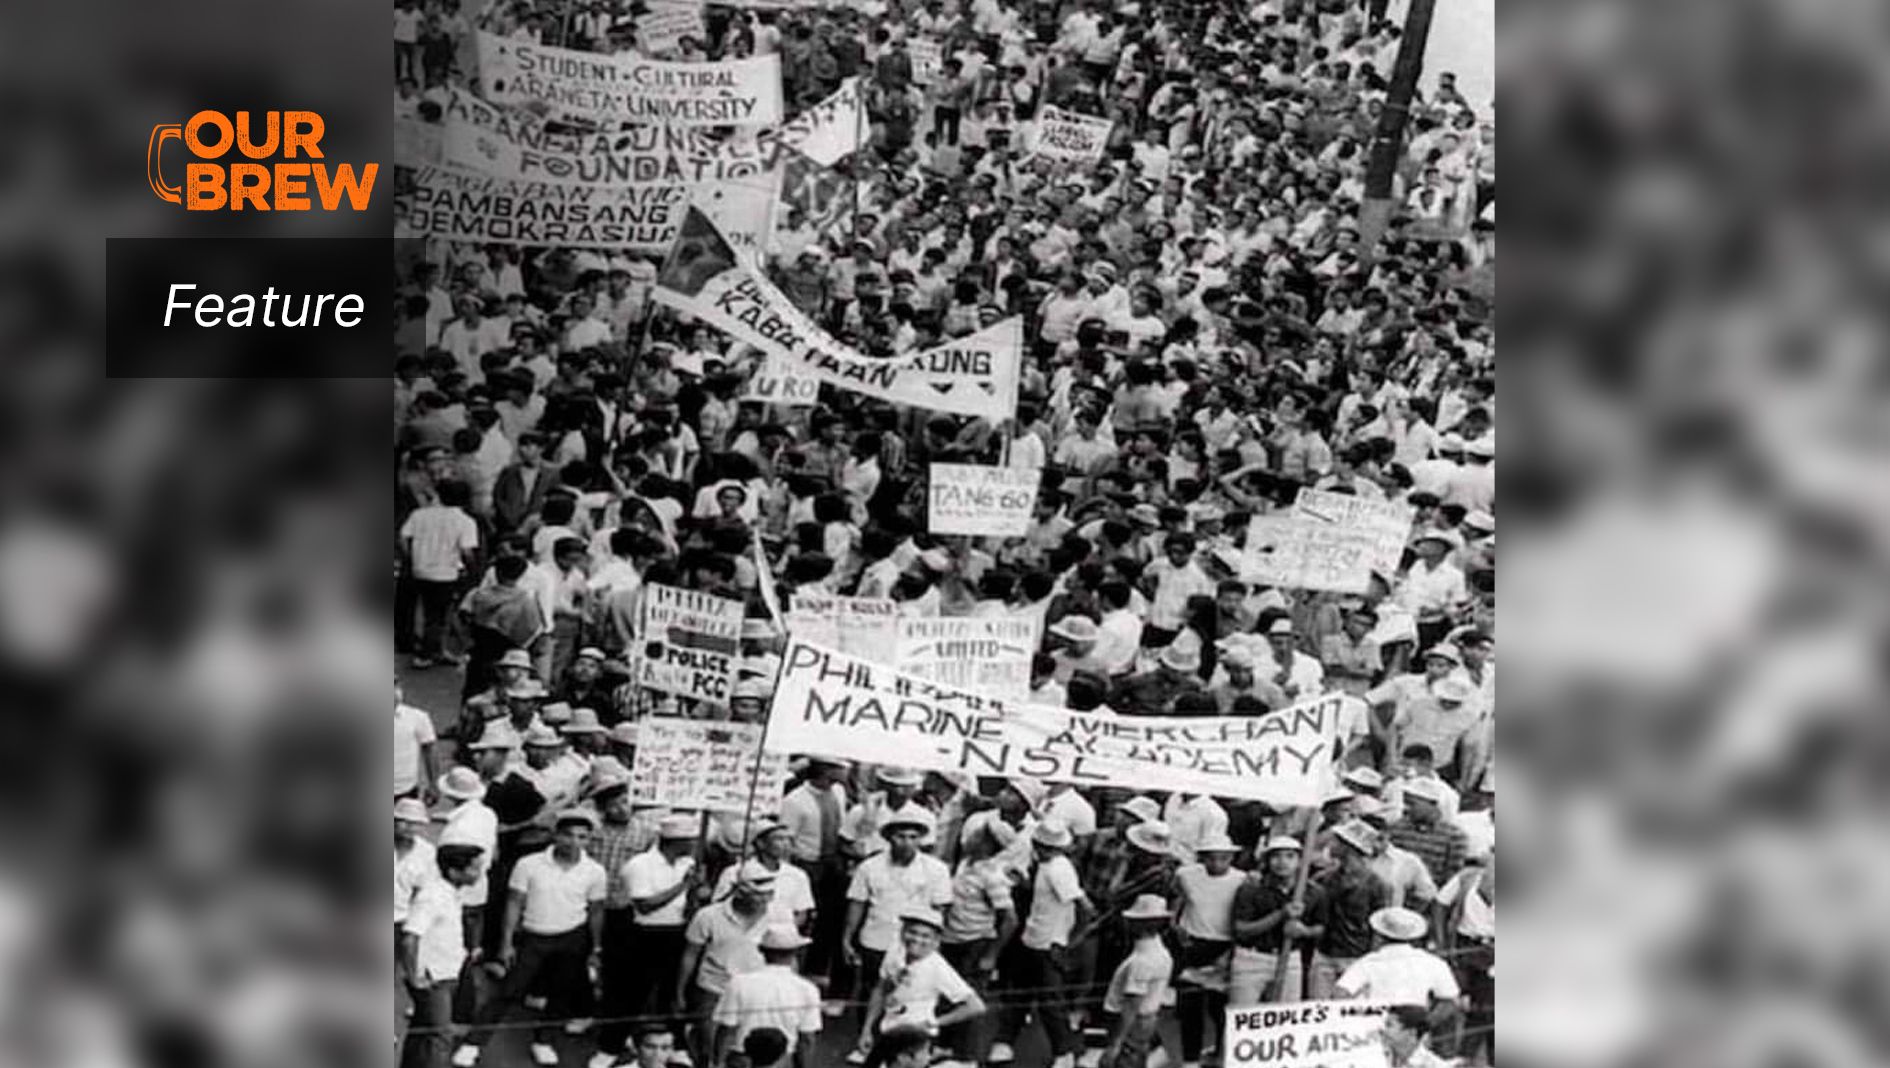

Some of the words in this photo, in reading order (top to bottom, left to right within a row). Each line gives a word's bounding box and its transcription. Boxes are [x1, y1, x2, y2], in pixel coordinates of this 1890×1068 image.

[516, 48, 616, 82] STUDENT
[626, 97, 757, 120] UNIVERSITY
[412, 186, 670, 224] PAMBANSANG
[667, 649, 731, 675] POLICE
[803, 688, 1004, 740] MARINE
[1233, 1033, 1299, 1062] OUR
